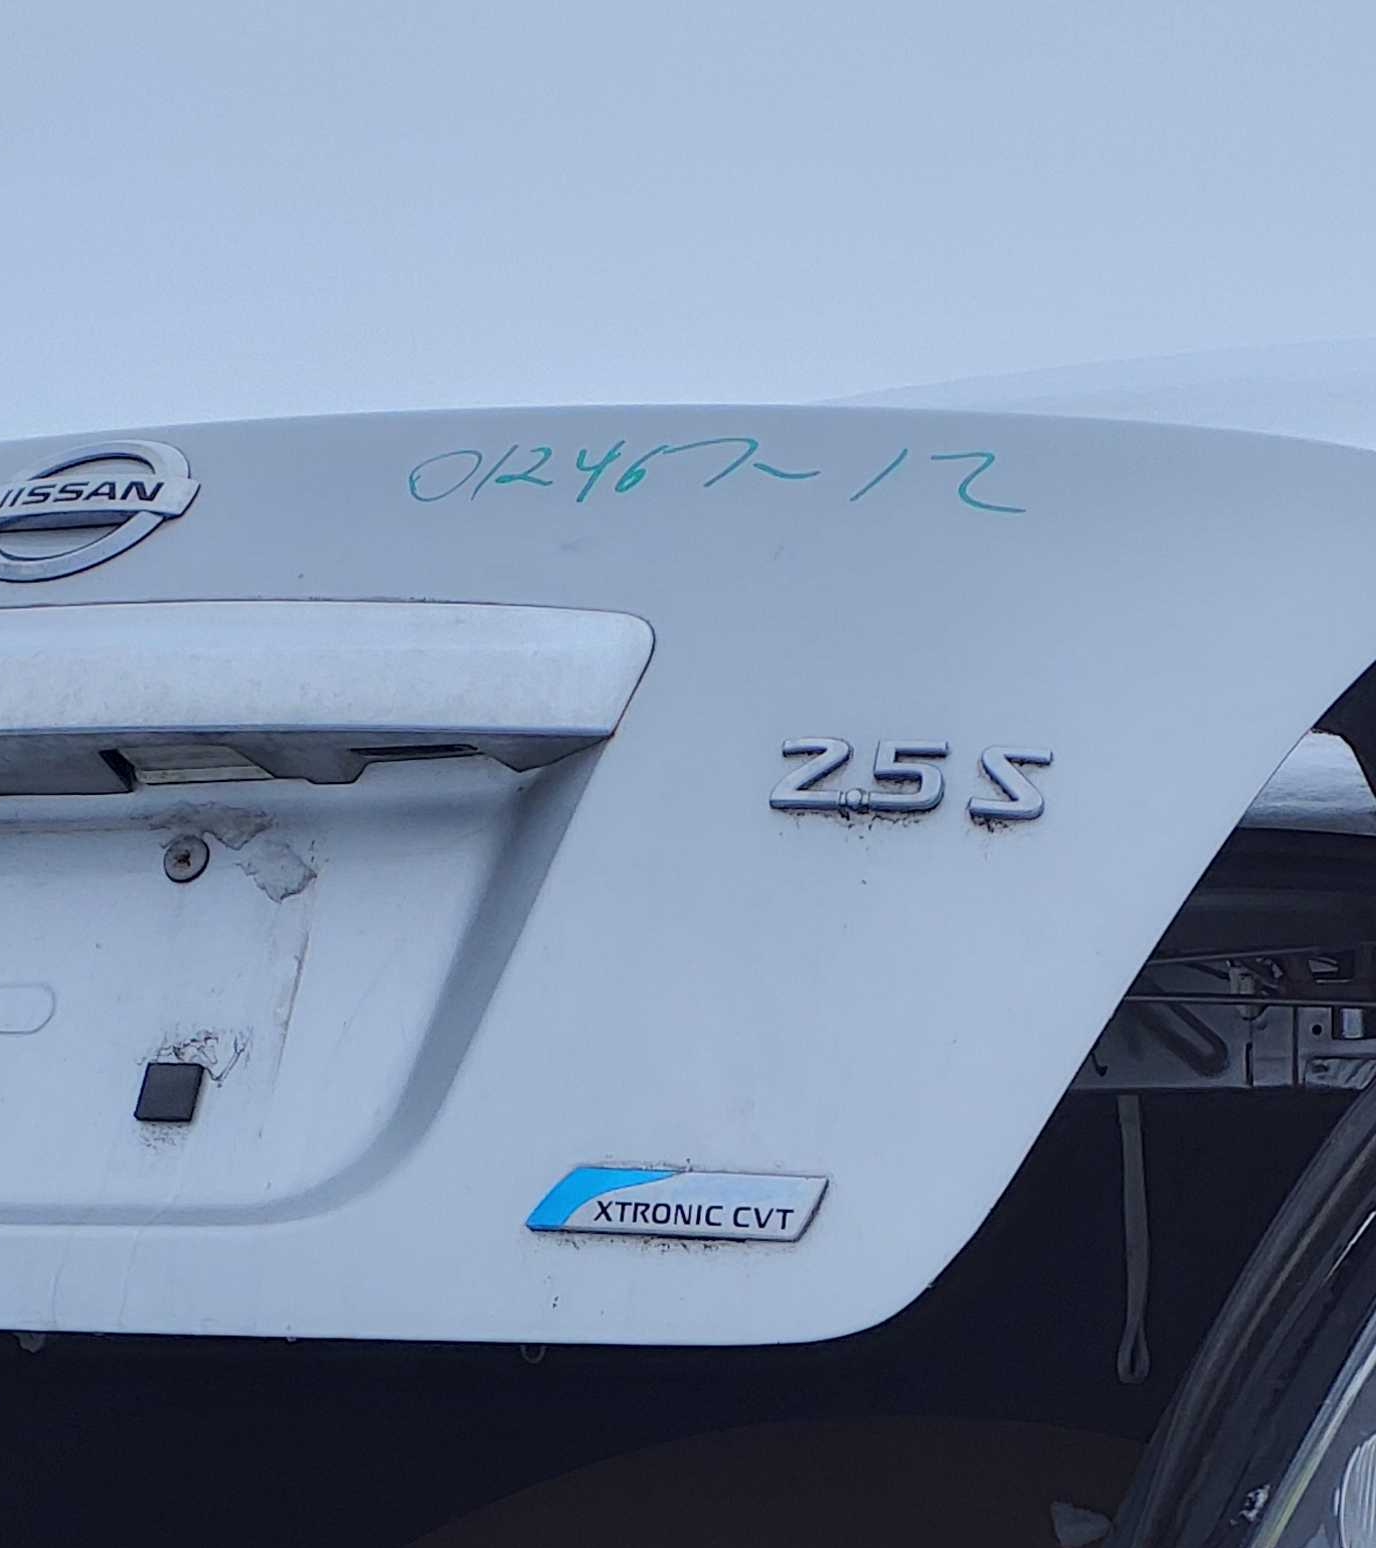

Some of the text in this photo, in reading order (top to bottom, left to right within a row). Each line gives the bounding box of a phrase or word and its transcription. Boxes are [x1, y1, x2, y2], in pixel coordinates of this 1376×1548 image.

[769, 737, 1054, 820] 2.5 S
[593, 1200, 795, 1231] XTRONIC CVT
